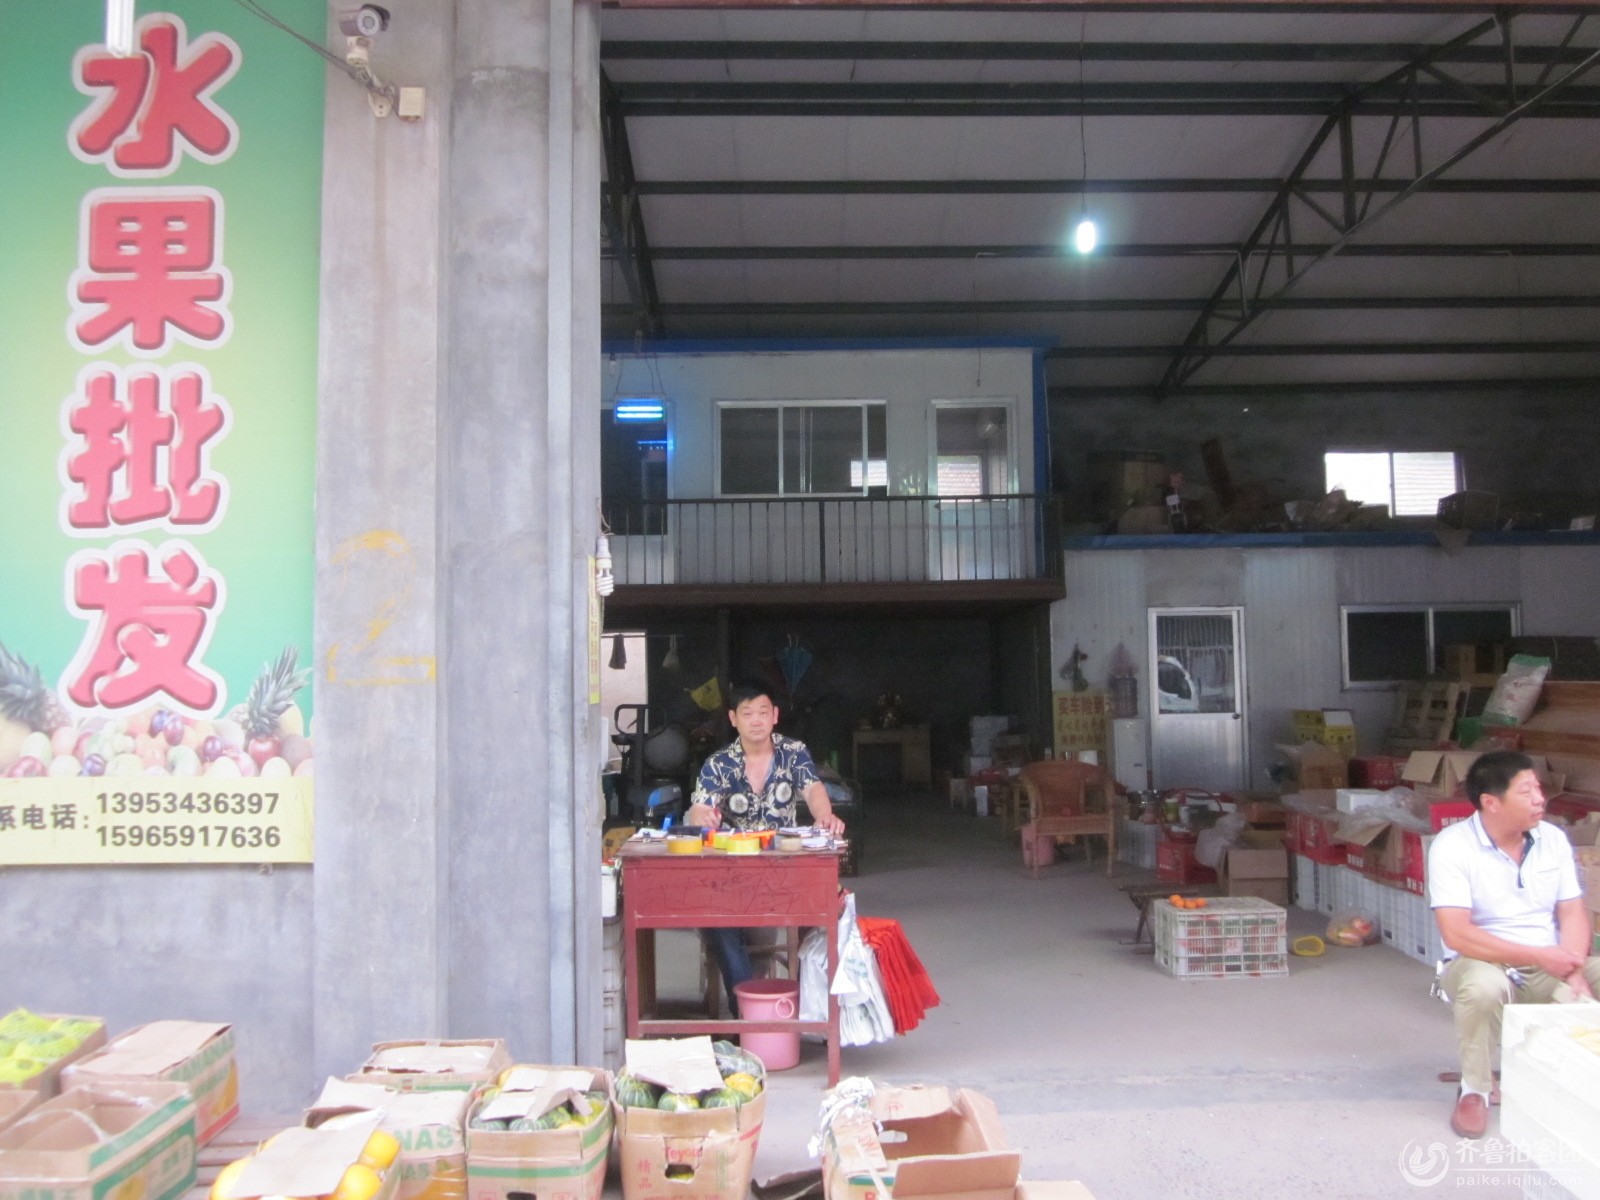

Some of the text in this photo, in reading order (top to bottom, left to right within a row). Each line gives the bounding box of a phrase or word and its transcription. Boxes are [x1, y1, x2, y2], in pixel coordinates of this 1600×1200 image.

[67, 14, 240, 714] 水果批发
[96, 792, 279, 815] 13953436397
[96, 825, 281, 848] 15965917636
